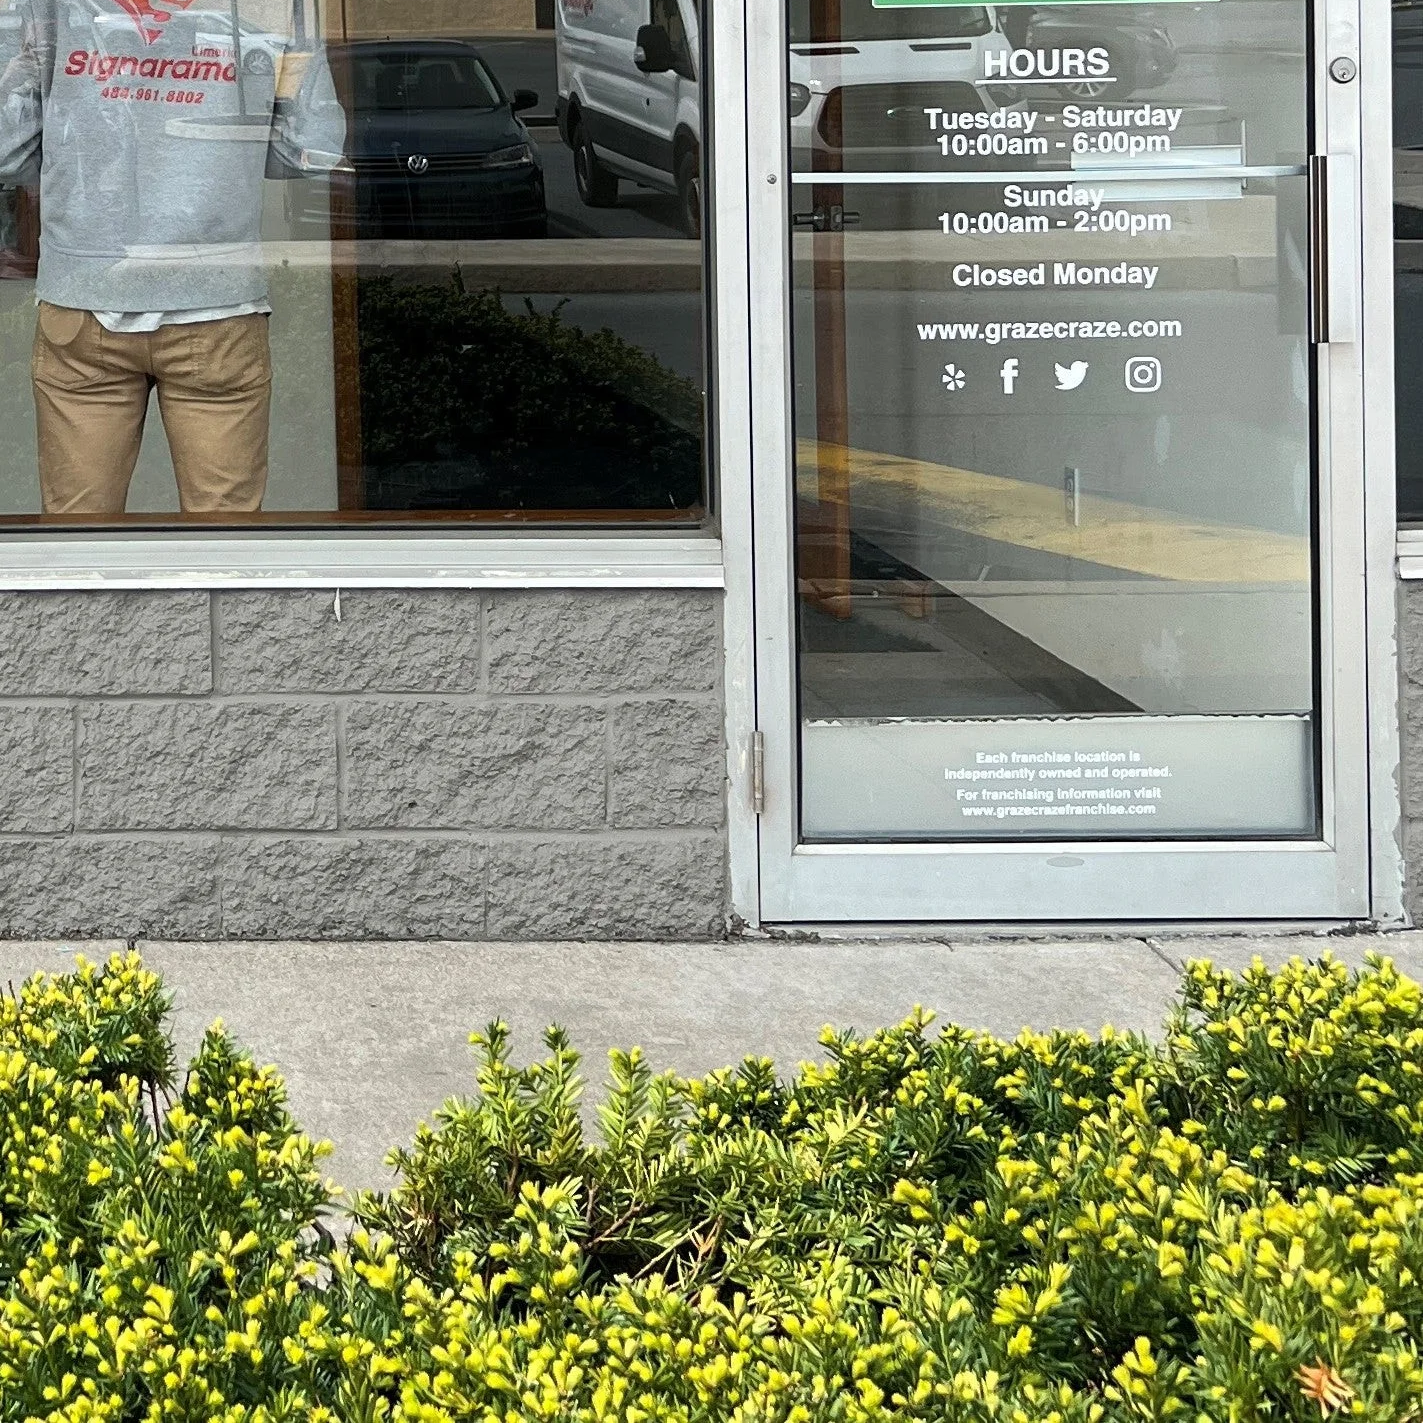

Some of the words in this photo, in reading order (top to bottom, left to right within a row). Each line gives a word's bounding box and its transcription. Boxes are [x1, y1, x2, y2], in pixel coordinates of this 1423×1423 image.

[64, 50, 237, 83] Signarama
[984, 48, 1110, 78] HOURS
[923, 107, 1038, 133] Tuesday
[1062, 104, 1183, 131] Saturday
[936, 134, 1048, 156] 10:00am
[1073, 131, 1171, 157] 6:00pm
[1003, 185, 1105, 211] Sunday
[937, 212, 1049, 235] 10:00am
[1073, 209, 1172, 237] 2:00pm
[952, 263, 1045, 287] Closed
[1053, 261, 1159, 288] Monday
[917, 318, 1182, 344] www.grazecraze.com
[976, 751, 1008, 764] Each
[1011, 750, 1071, 764] franchise
[1074, 751, 1126, 764] location
[1129, 750, 1141, 763] is
[1039, 768, 1082, 780] owned
[1084, 766, 1109, 779] and
[1111, 765, 1173, 780] operated.
[956, 789, 978, 801] For
[981, 788, 1054, 803] franchising
[1057, 787, 1131, 800] information
[1134, 786, 1162, 800] visit
[962, 802, 1156, 819] www.grazecrazefranchise.com
